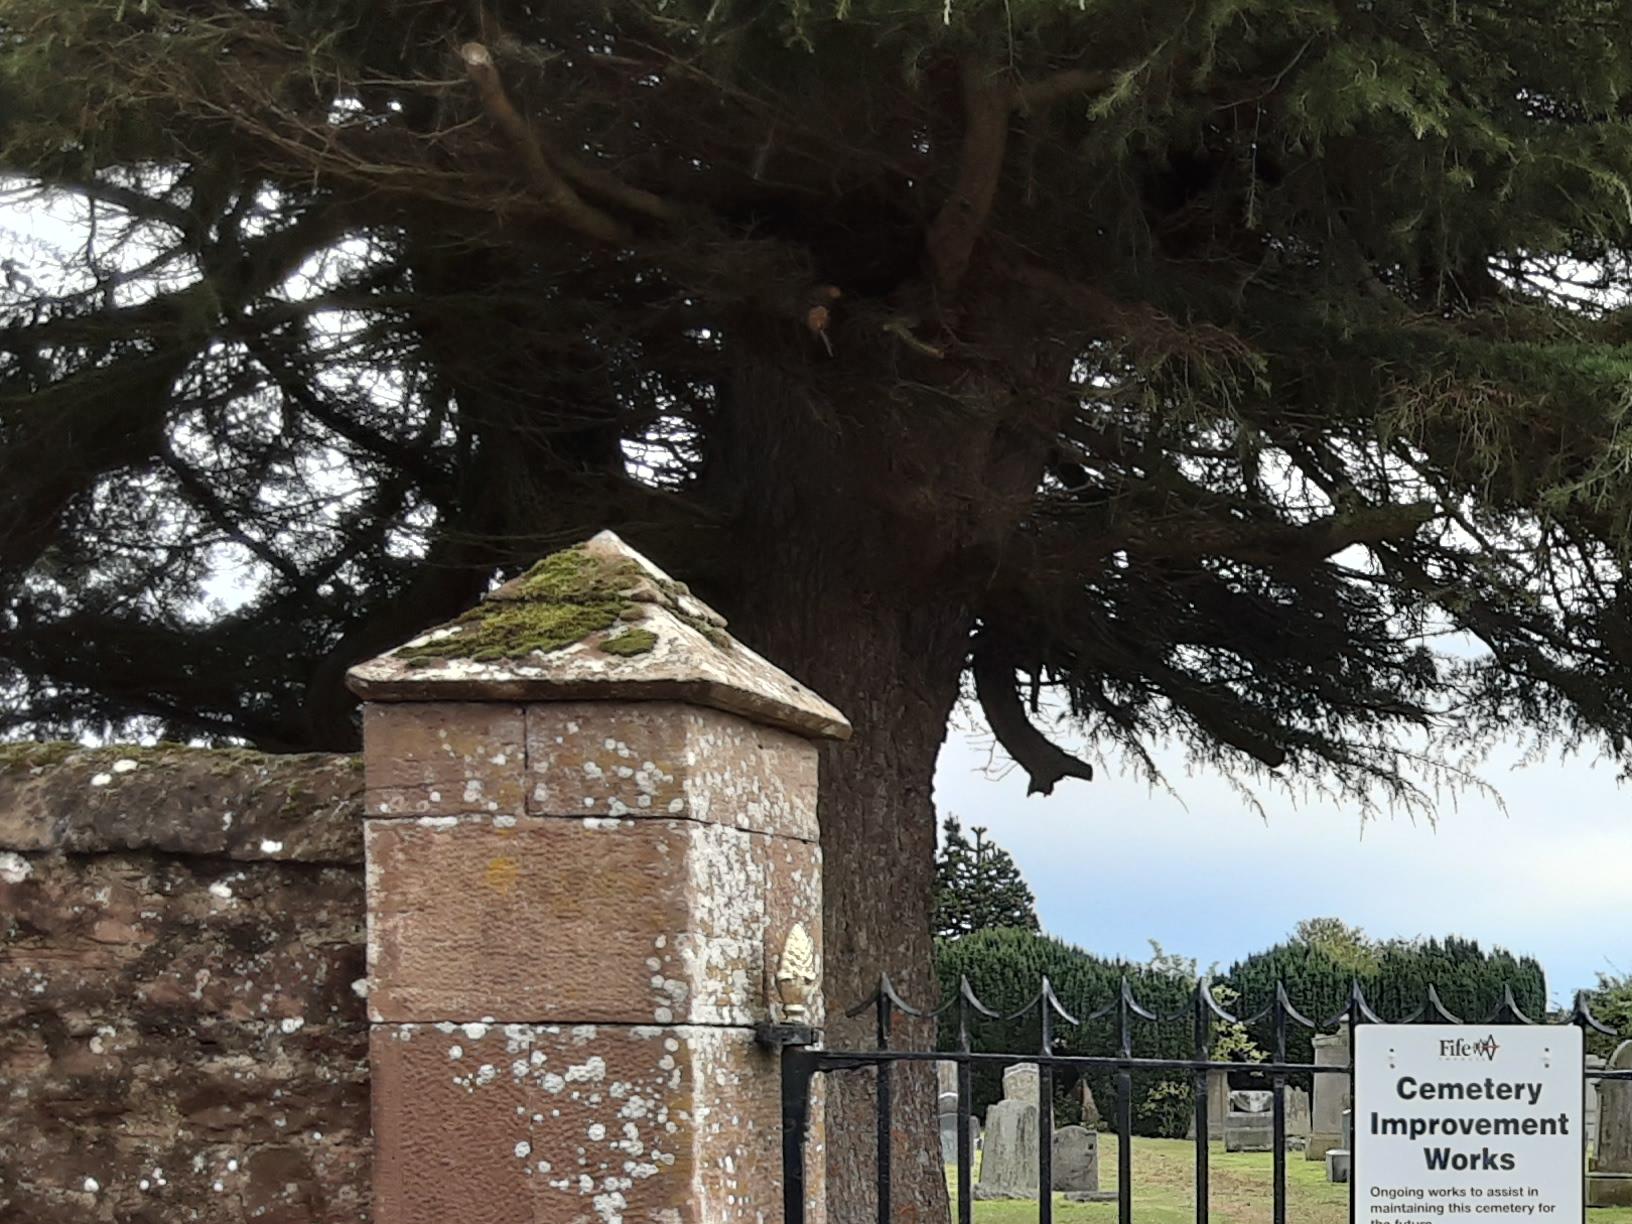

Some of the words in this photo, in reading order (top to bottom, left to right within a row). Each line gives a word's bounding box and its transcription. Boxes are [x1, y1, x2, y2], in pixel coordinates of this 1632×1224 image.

[1439, 1038, 1471, 1057] Fife
[1397, 1076, 1542, 1105] Cemetery
[1371, 1112, 1569, 1140] Improvement
[1424, 1147, 1515, 1171] Works
[1370, 1186, 1424, 1199] Ongoing
[1428, 1187, 1466, 1197] works
[1470, 1188, 1483, 1197] to
[1487, 1187, 1524, 1197] assist
[1528, 1186, 1539, 1197] in
[1370, 1203, 1444, 1215] maintaining
[1448, 1203, 1471, 1213] this
[1475, 1204, 1534, 1215] cemetery
[1538, 1202, 1556, 1213] for
